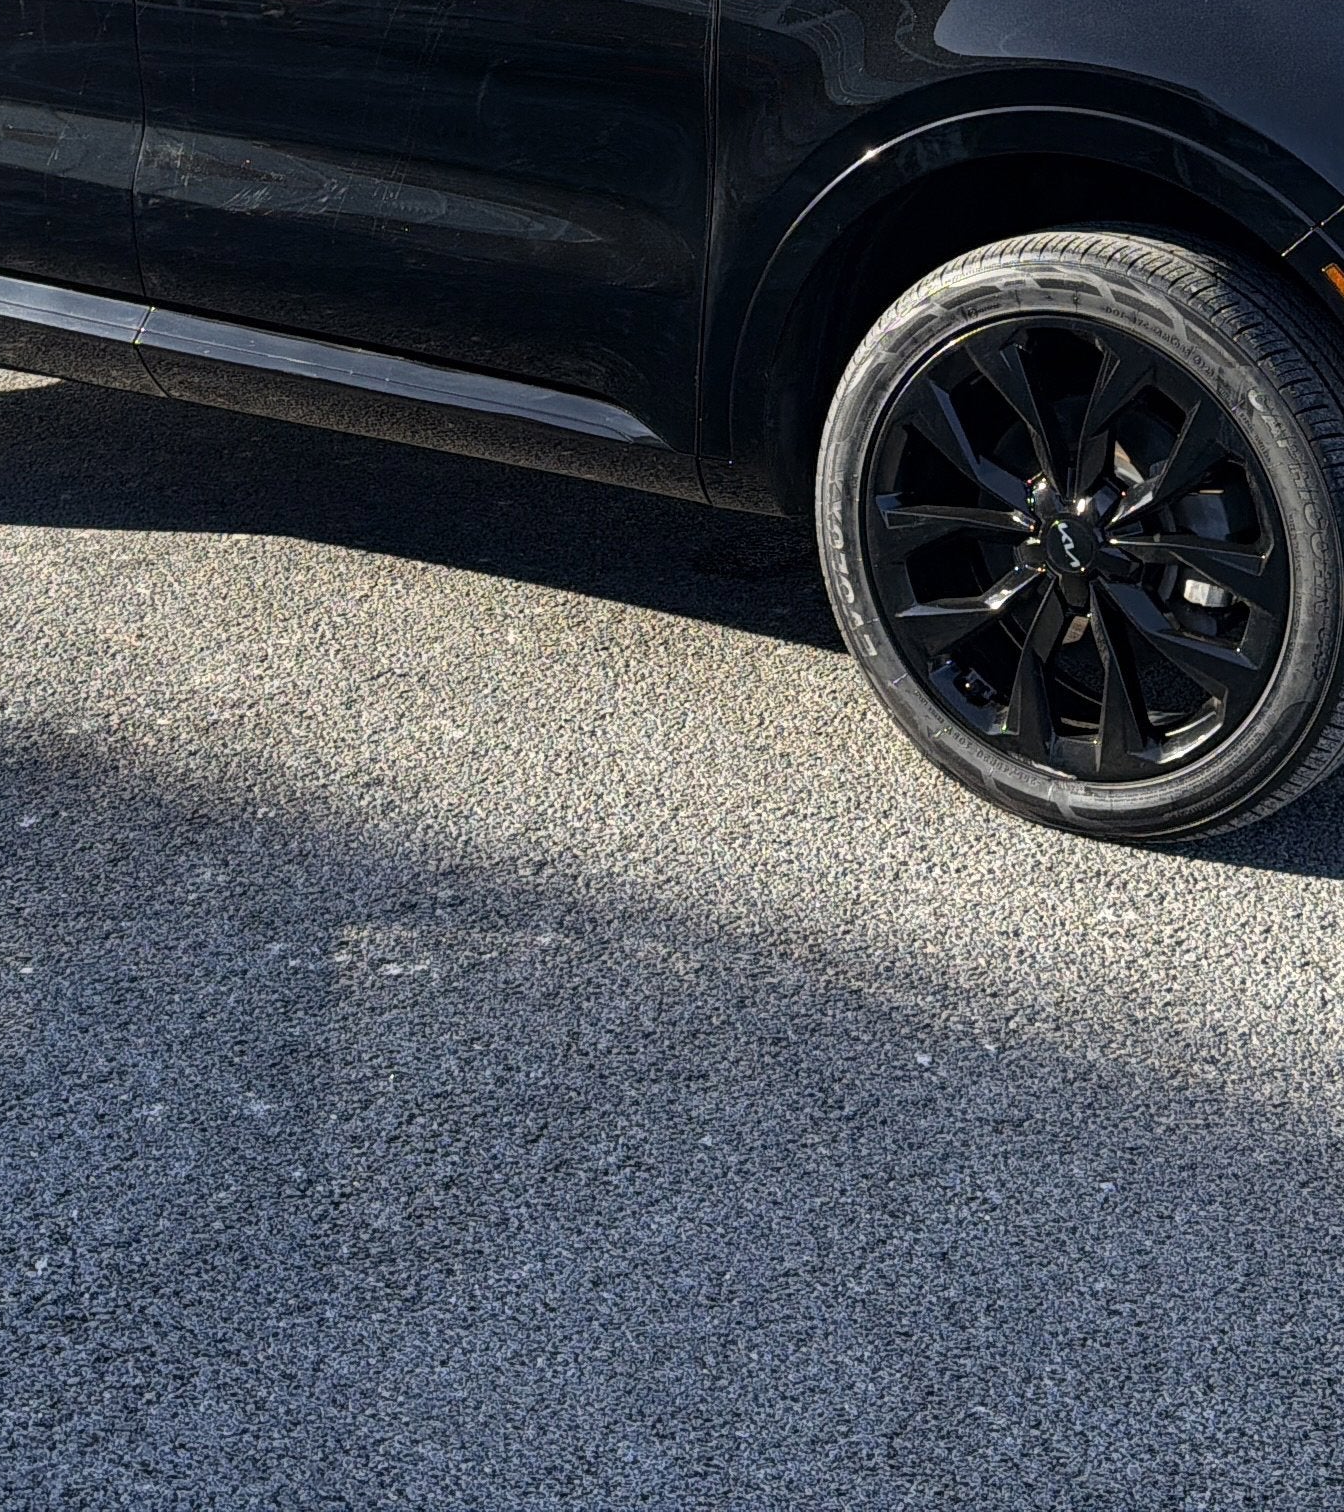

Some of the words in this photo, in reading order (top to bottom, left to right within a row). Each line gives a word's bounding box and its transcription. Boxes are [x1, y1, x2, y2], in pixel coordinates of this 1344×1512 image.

[827, 470, 878, 658] EVOLUXX
[1058, 522, 1081, 568] KIA
[1246, 387, 1335, 616] CAPRICORN
